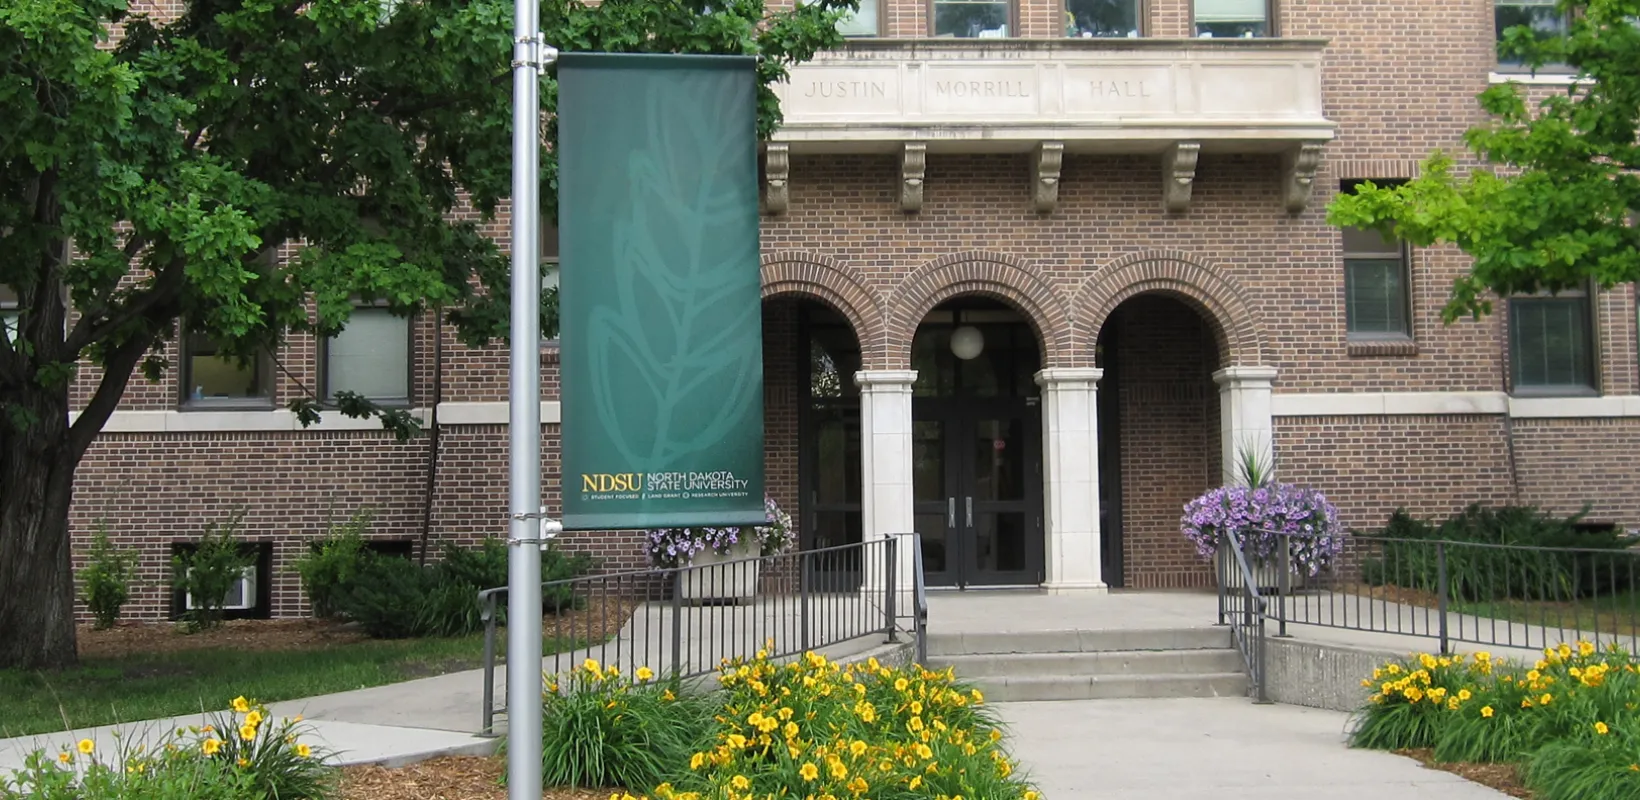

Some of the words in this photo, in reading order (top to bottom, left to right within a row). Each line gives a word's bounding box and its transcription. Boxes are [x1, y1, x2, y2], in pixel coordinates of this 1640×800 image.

[804, 80, 886, 99] JUSTIN
[935, 80, 1030, 98] MORRILL
[1089, 80, 1151, 98] HALL
[581, 472, 644, 492] NDSU
[647, 472, 686, 482] NORTH
[689, 471, 734, 481] DAKOTA
[647, 481, 681, 491] STATE
[683, 480, 748, 490] UNIVERSITY
